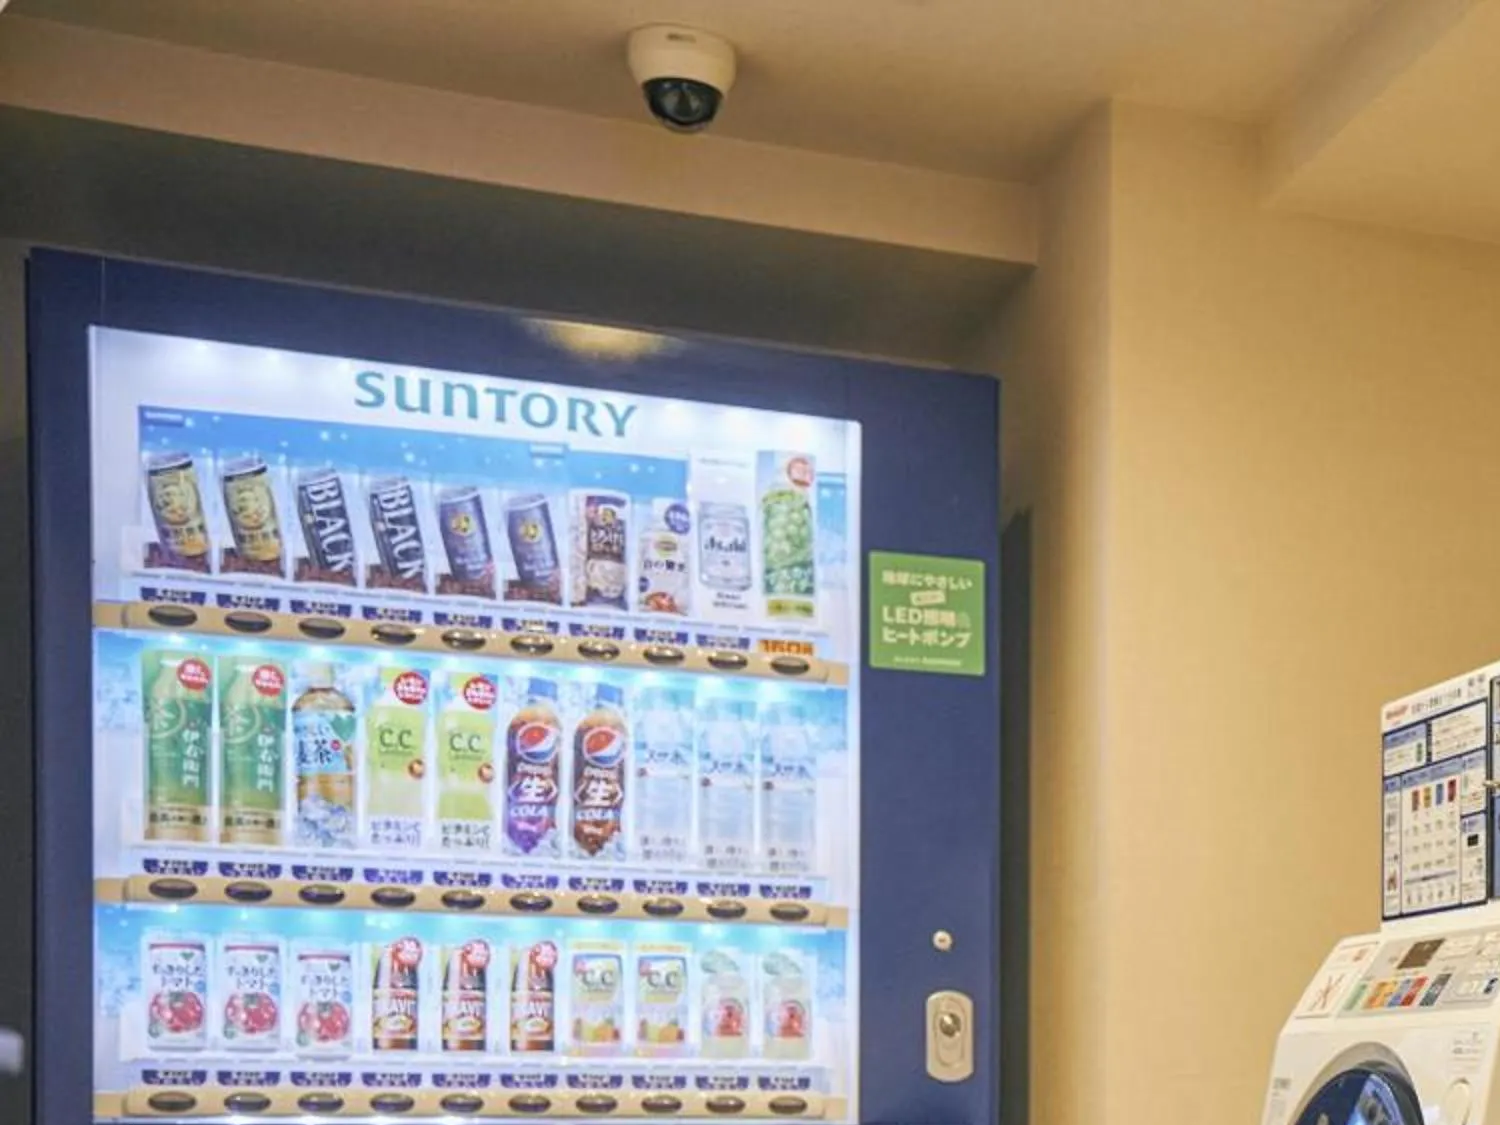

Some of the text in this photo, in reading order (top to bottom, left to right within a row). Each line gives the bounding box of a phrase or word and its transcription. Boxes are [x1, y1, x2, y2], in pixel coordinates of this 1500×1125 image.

[354, 370, 637, 438] SUNTORY
[306, 478, 353, 572] BLACK
[379, 486, 425, 578] BLACK
